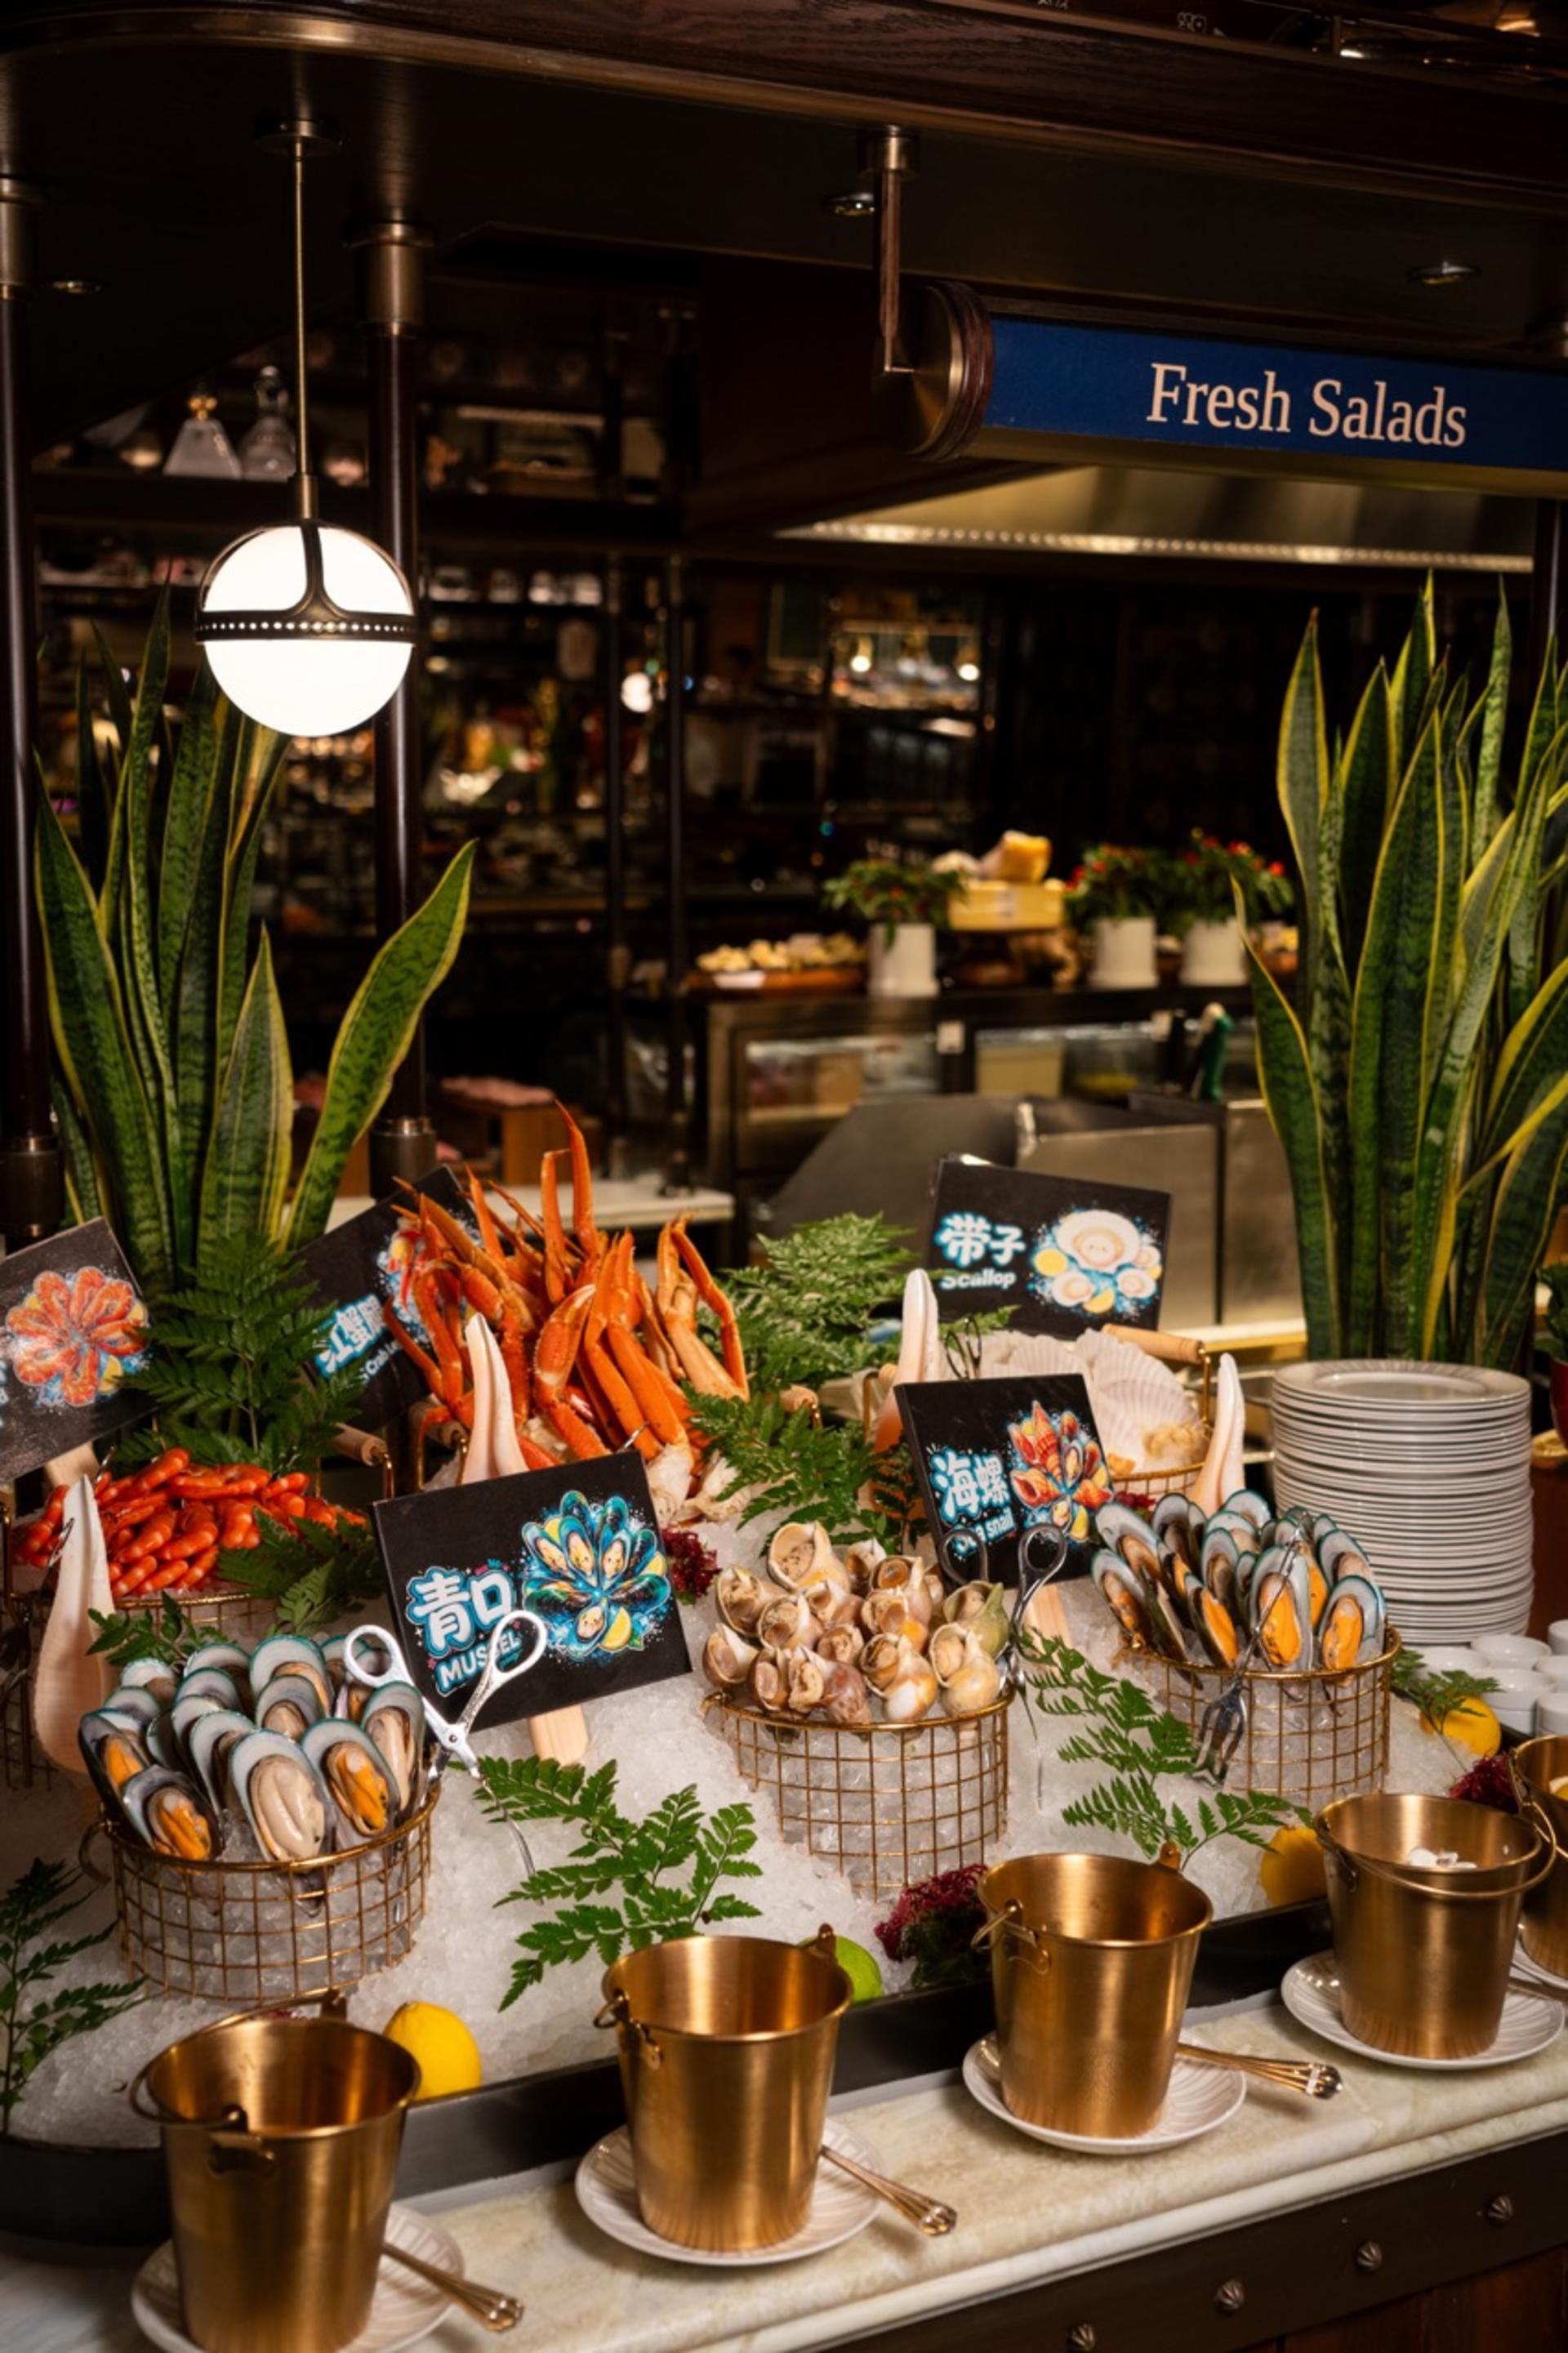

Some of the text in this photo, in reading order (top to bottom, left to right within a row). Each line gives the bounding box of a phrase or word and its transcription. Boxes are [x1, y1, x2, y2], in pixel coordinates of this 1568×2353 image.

[1147, 362, 1468, 448] Fresh Salads
[939, 1214, 1026, 1266] 带子
[932, 1448, 1010, 1519] 海螺
[984, 1506, 1015, 1540] snail
[411, 1568, 514, 1652] 青口
[439, 1629, 522, 1690] MUSEL
